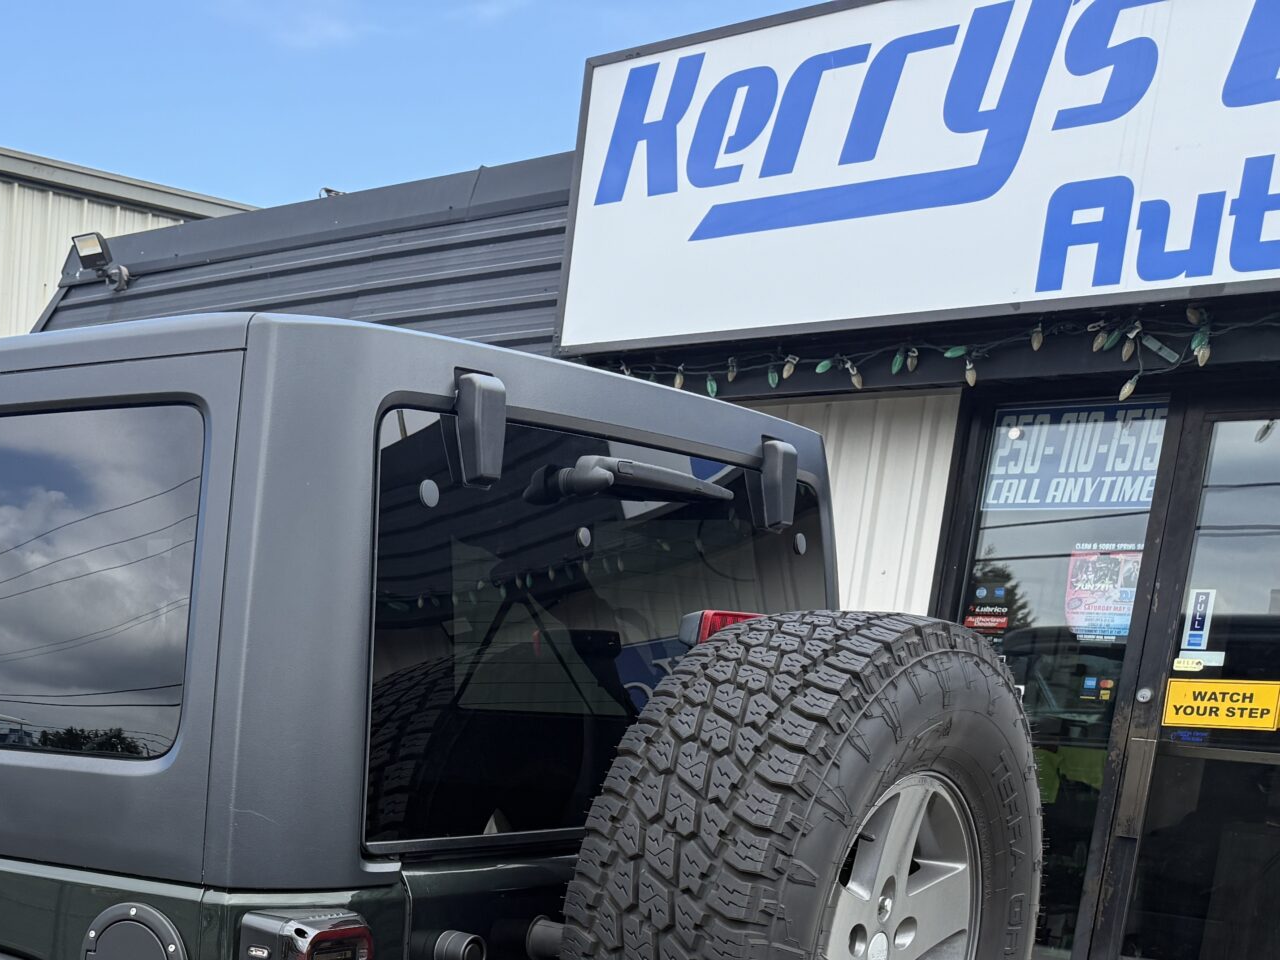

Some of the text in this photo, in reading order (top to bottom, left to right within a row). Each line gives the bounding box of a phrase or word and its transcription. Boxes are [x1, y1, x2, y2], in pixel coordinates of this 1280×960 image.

[594, 0, 1166, 242] Kerrys
[986, 478, 1041, 504] CALL
[975, 605, 1008, 613] Lubrico
[1194, 595, 1206, 628] PULL
[1192, 691, 1254, 703] WATCH
[1173, 704, 1271, 719] YOUR STEP
